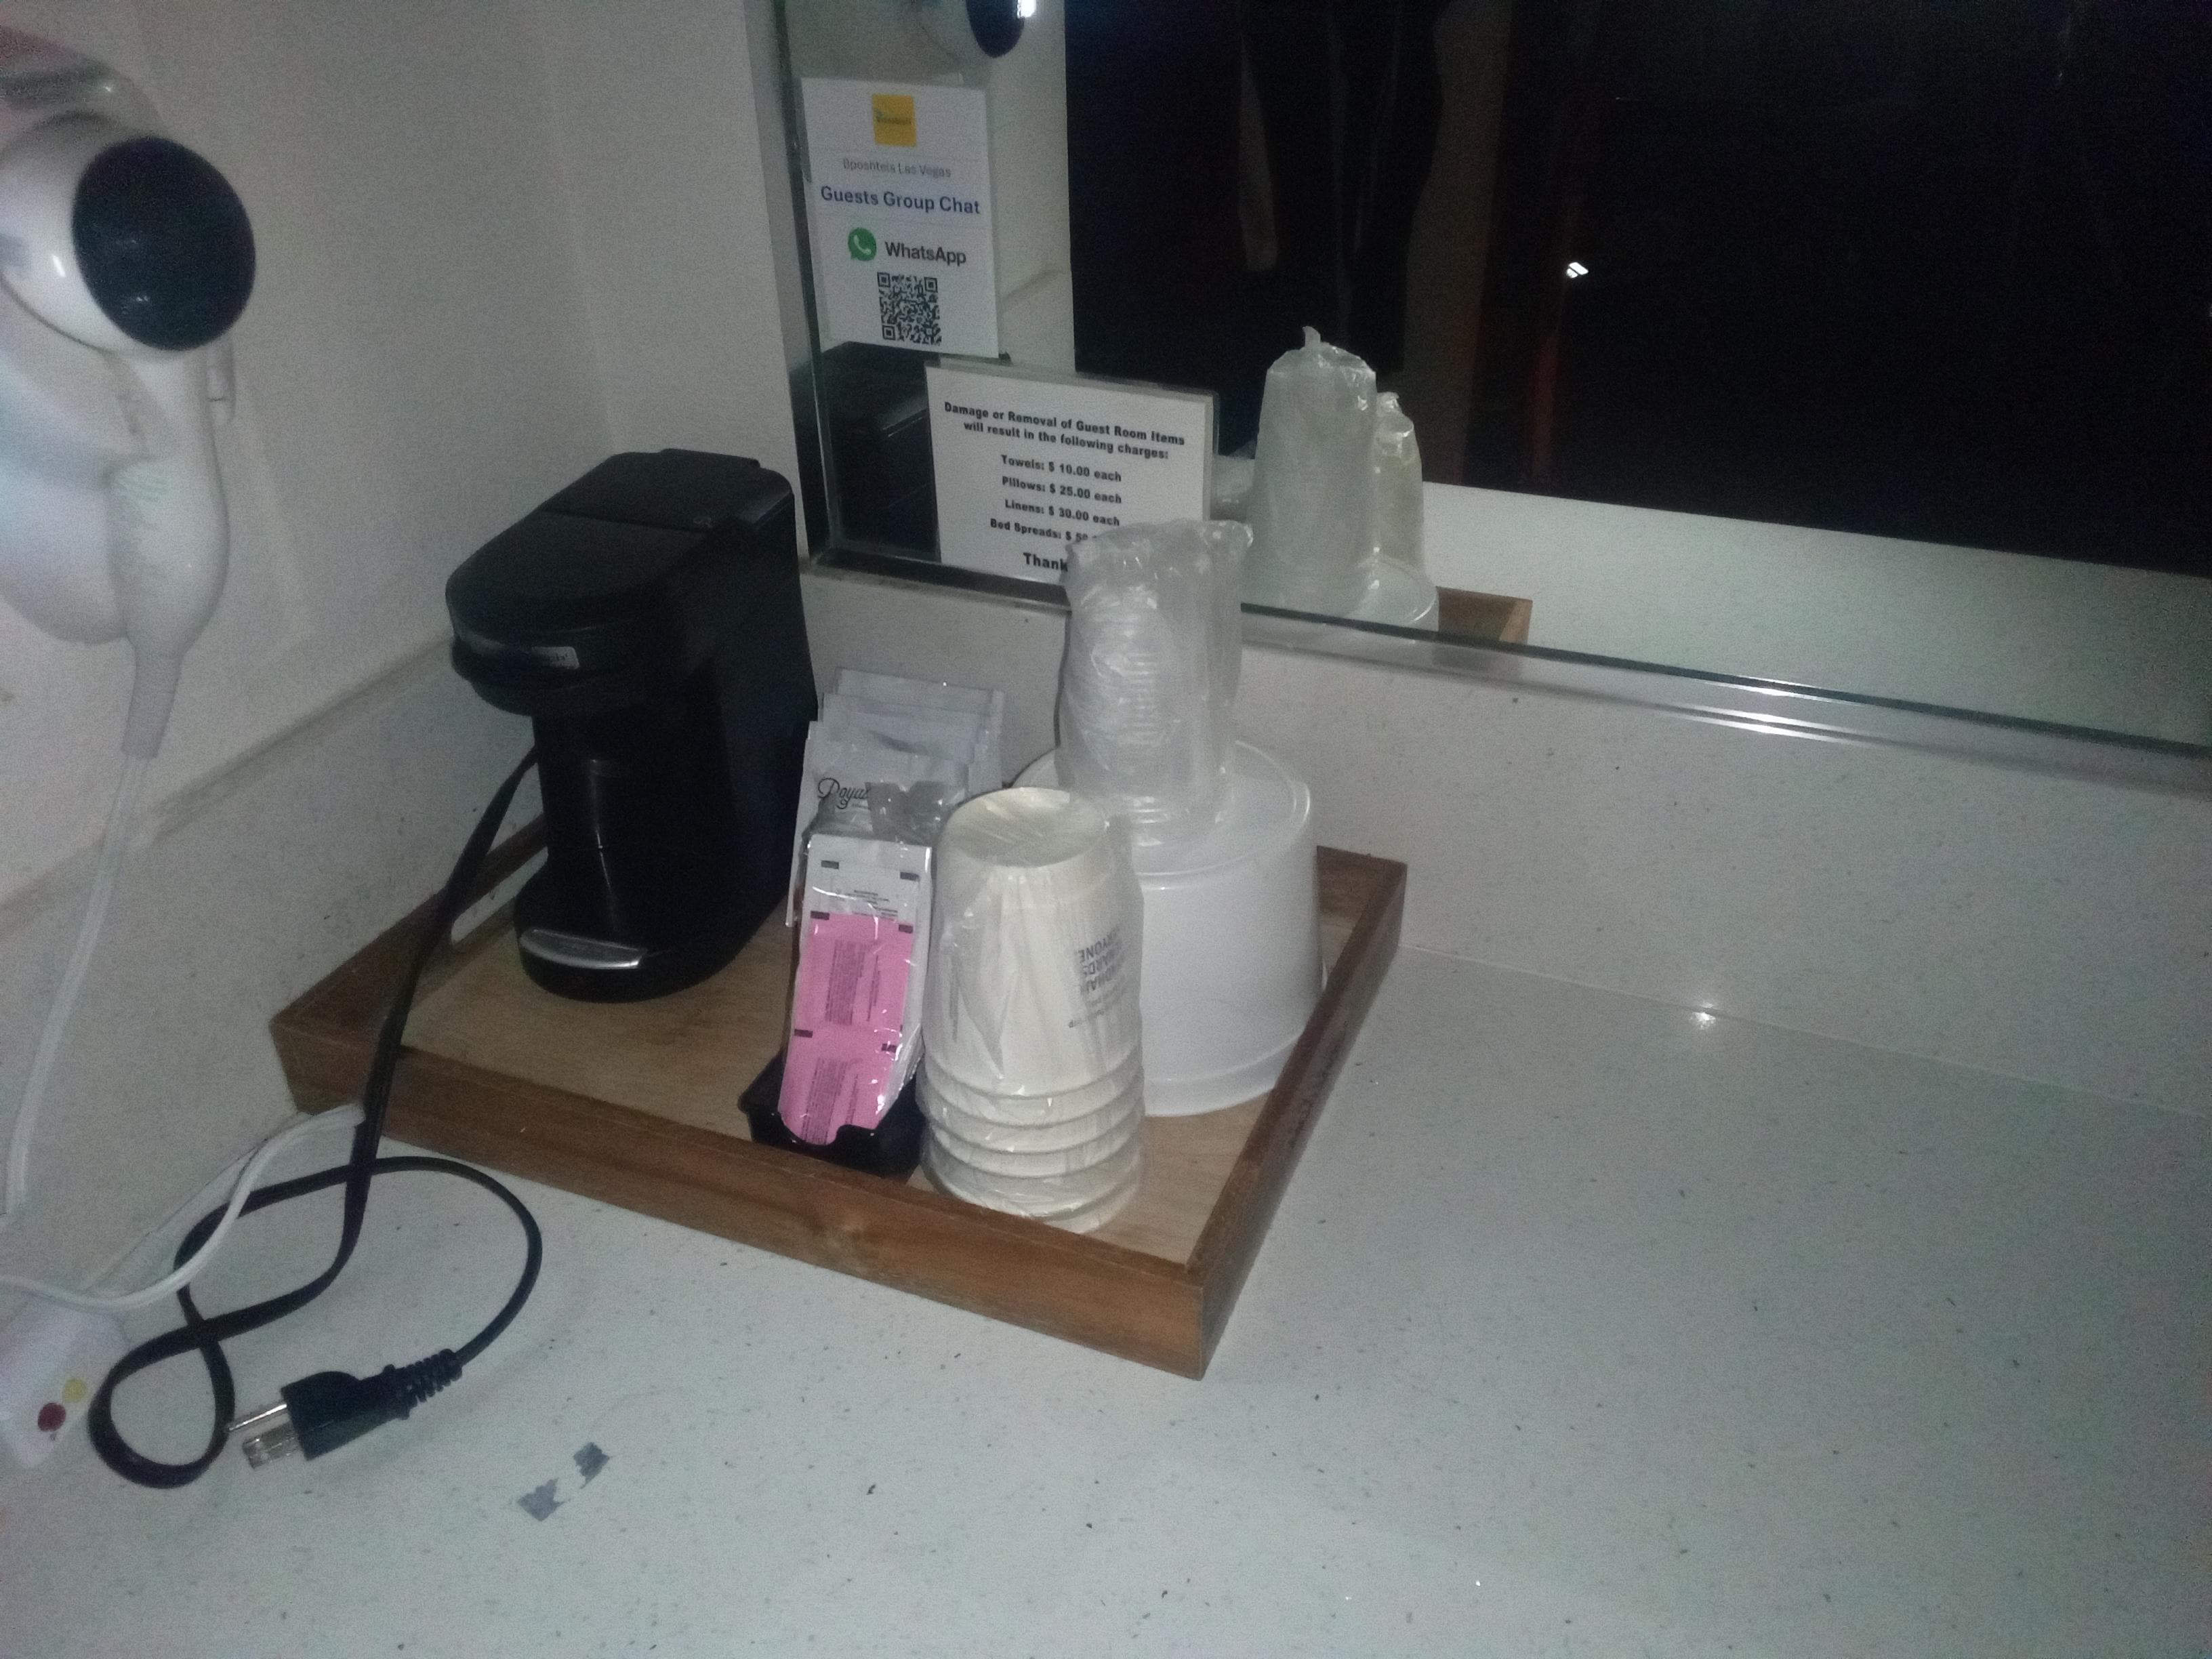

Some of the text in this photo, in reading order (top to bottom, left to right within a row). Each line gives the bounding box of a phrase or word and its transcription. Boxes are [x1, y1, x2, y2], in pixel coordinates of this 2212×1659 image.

[898, 162, 916, 175] Las
[919, 165, 951, 178] Vegas
[820, 186, 981, 214] Guests Group Chat
[884, 241, 967, 266] WhatsApp
[944, 402, 989, 419] Damage
[992, 411, 1004, 420] or
[1008, 411, 1057, 428] Removal
[1061, 419, 1072, 429] of
[1076, 421, 1110, 435] Guest
[1114, 426, 1147, 440] Room
[964, 422, 1169, 459] will result in the following charges:
[1001, 454, 1122, 483] Towels: $ 10.00 each
[1002, 476, 1122, 504] Pillows: $ 25.00 each
[1004, 499, 1120, 527] Linens: $ 30.00 each
[990, 518, 1010, 531] Bed
[1014, 522, 1061, 539] Spreads:
[1065, 531, 1072, 541] $
[1023, 552, 1068, 573] Thank
